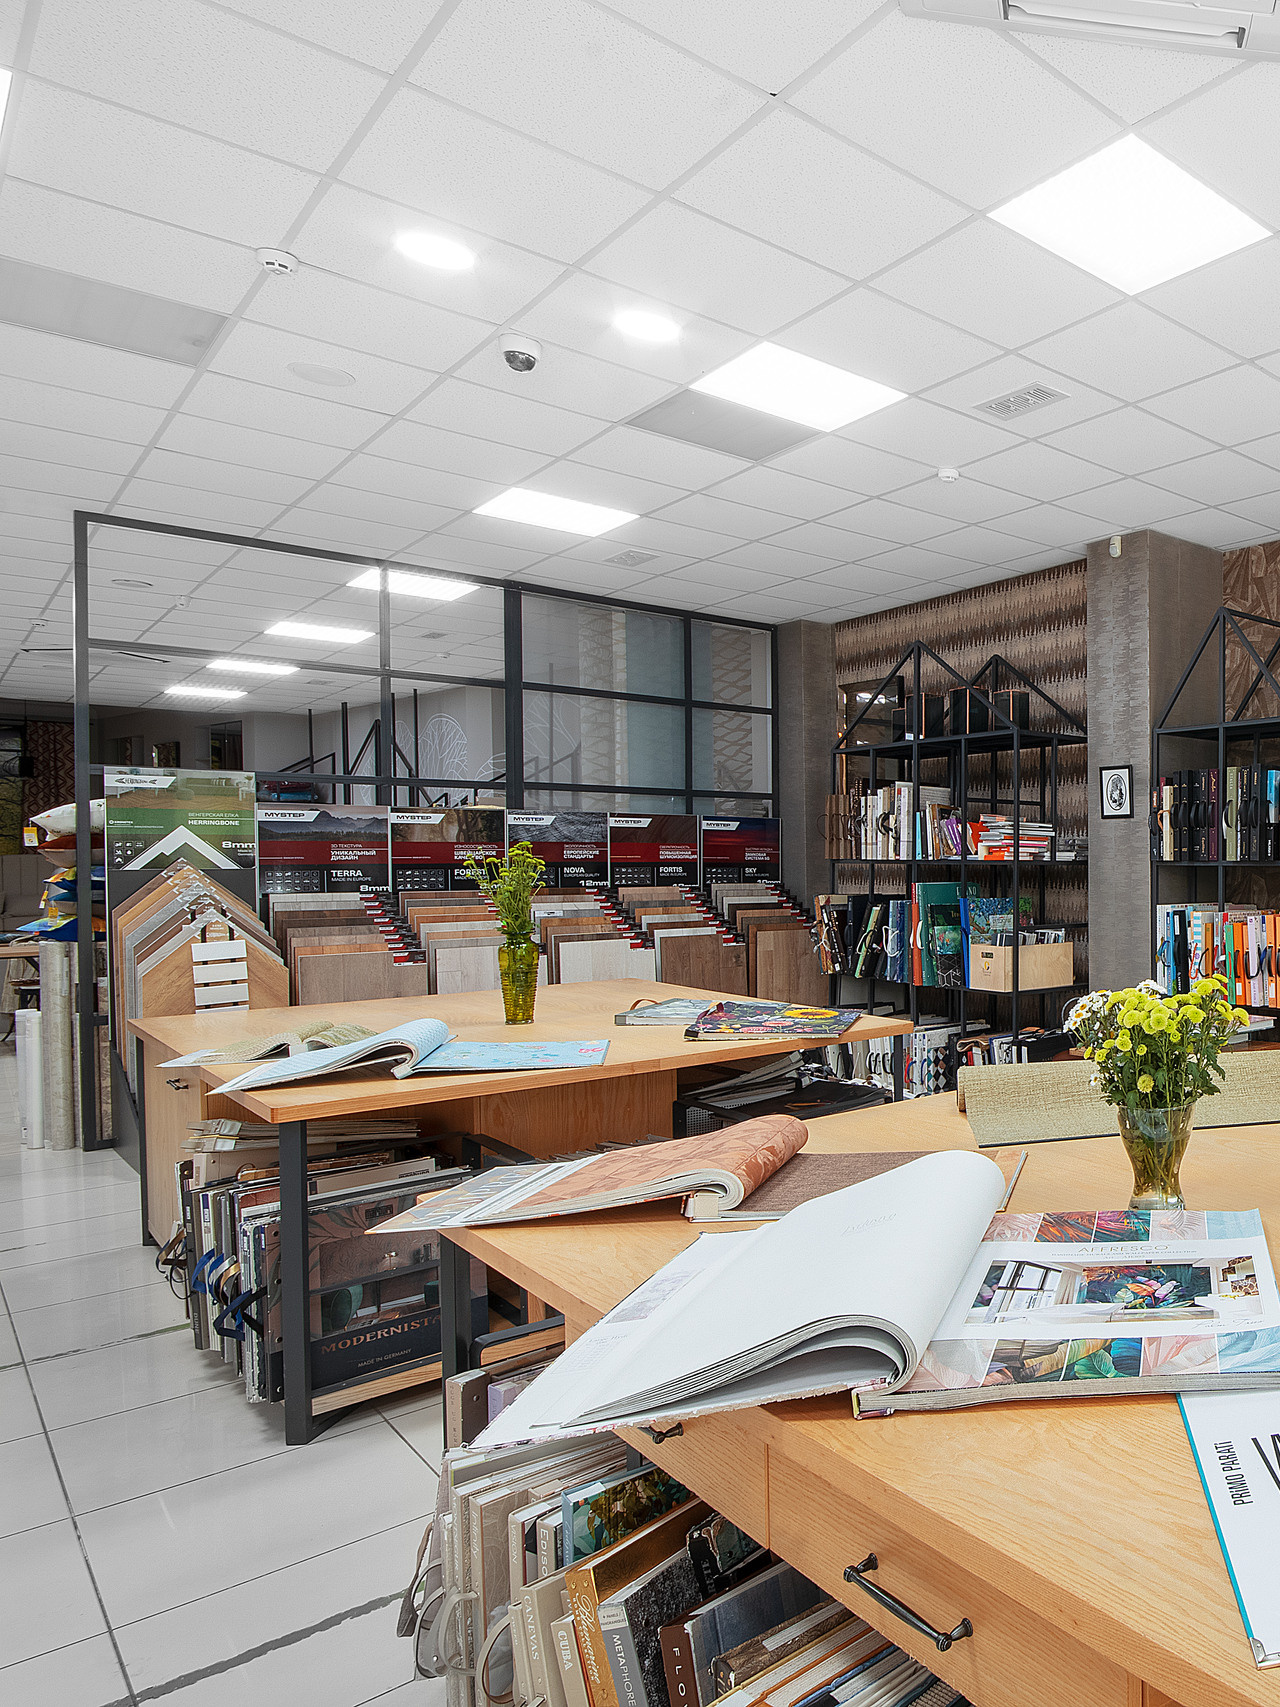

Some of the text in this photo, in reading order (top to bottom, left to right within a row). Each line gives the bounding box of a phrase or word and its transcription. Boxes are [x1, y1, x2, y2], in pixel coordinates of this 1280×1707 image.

[1078, 1245, 1169, 1253] AFFRESCO
[357, 1356, 375, 1368] MADE
[383, 1348, 412, 1361] GERMANY
[471, 1511, 479, 1559] Infinity
[510, 1523, 518, 1564] VISION
[540, 1528, 549, 1577] EDISO
[523, 1595, 540, 1661] CANEVAS
[557, 1630, 573, 1671] CUBA
[575, 1593, 601, 1685] Blumarine
[612, 1634, 637, 1707] METAPHORE
